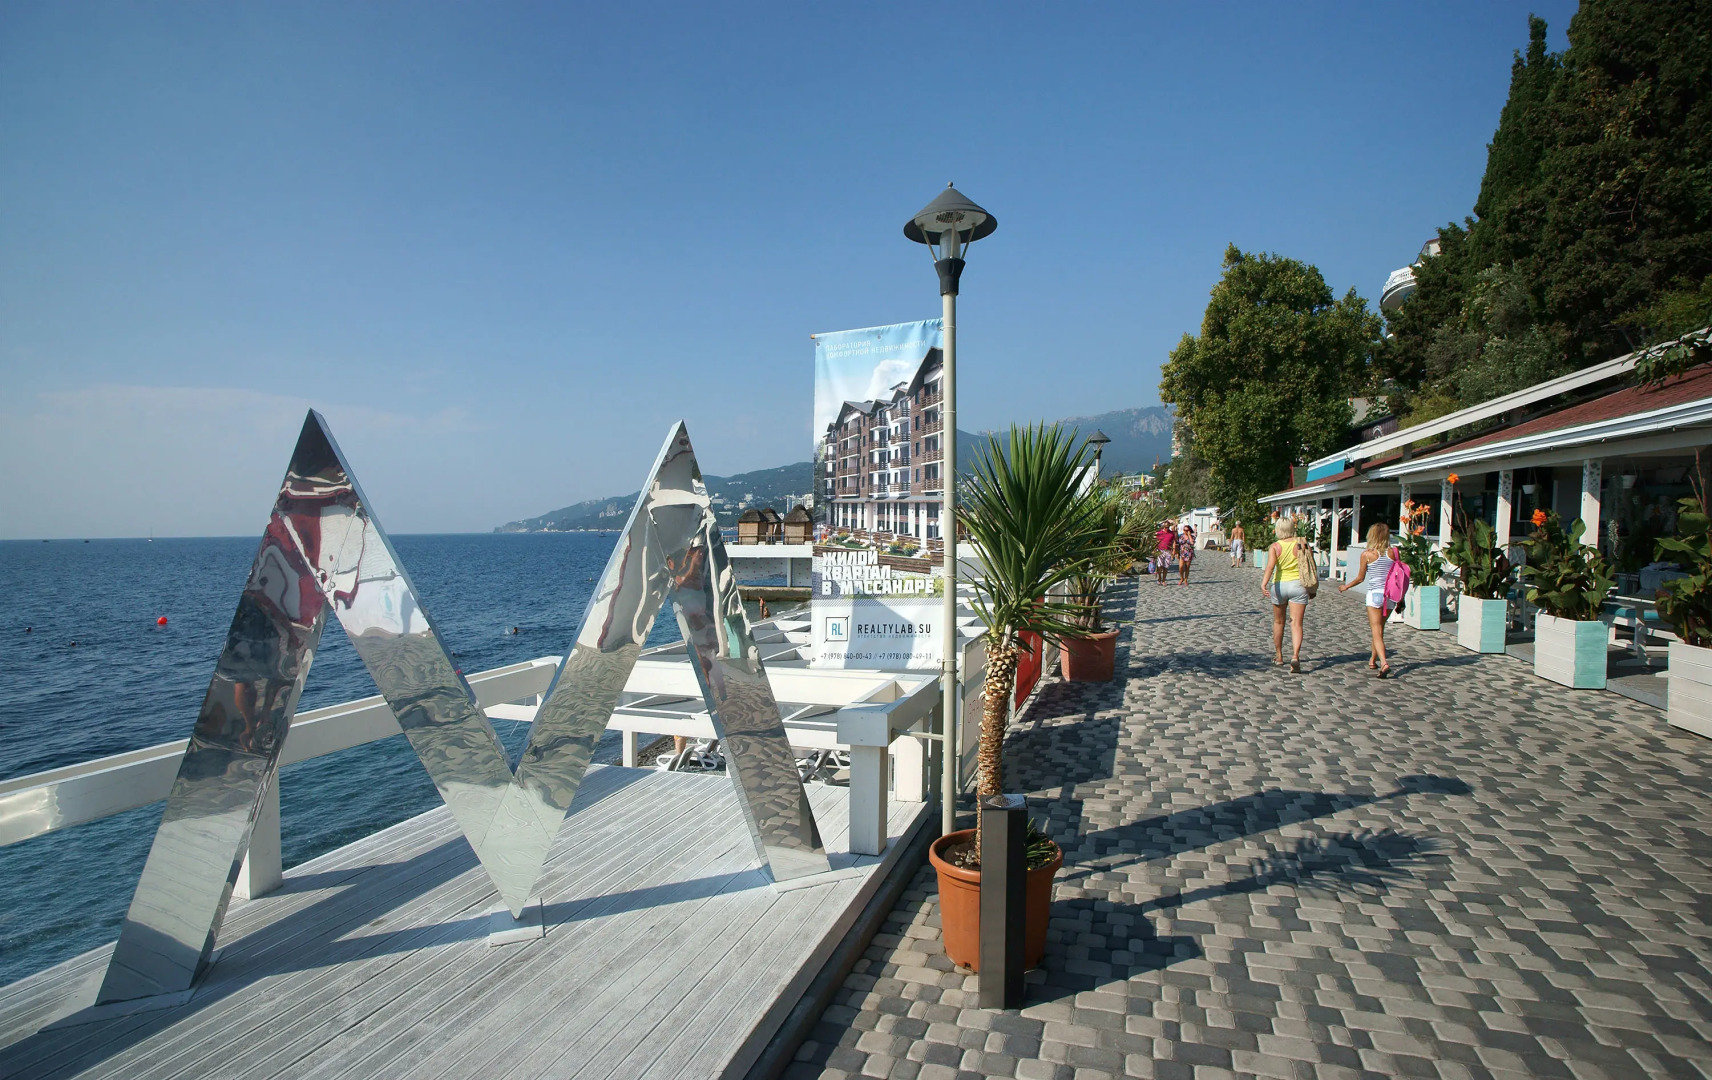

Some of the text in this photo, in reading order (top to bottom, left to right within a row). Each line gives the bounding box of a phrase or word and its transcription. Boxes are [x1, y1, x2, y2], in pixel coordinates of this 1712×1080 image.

[822, 546, 879, 566] ЖИЛОЙ
[822, 565, 891, 580] КВАРТАЛ
[822, 579, 935, 595] В МАССАНДРЕ
[831, 623, 843, 635] RL
[857, 623, 931, 634] REALTYLAB.SU
